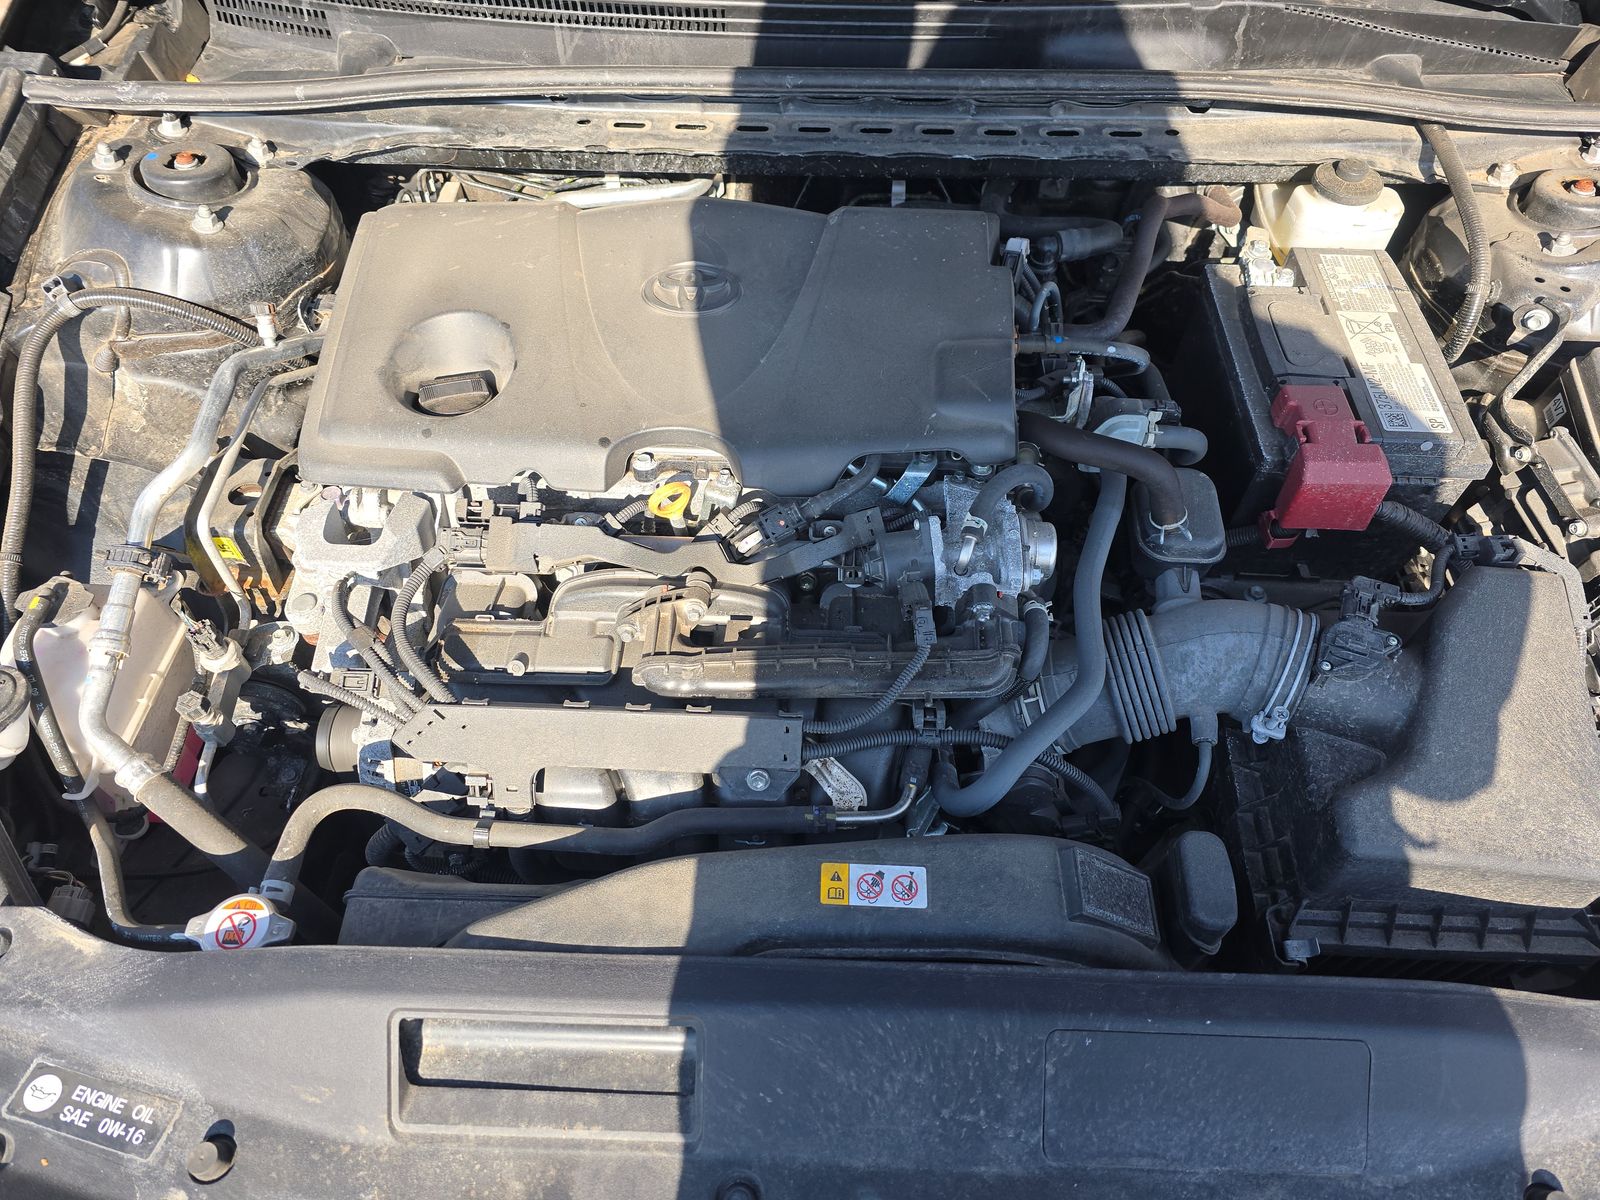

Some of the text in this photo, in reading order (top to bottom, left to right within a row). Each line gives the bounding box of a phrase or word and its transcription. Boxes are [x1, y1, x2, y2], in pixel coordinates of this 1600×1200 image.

[1360, 362, 1393, 410] 375LN2-MF
[1552, 398, 1565, 417] 4V7
[1428, 418, 1446, 429] SP
[19, 625, 31, 645] WATER
[40, 713, 54, 739] WATER
[137, 932, 162, 942] WATER
[71, 1084, 154, 1125] ENGINE OIL
[59, 1105, 146, 1145] SAE 0W-16
